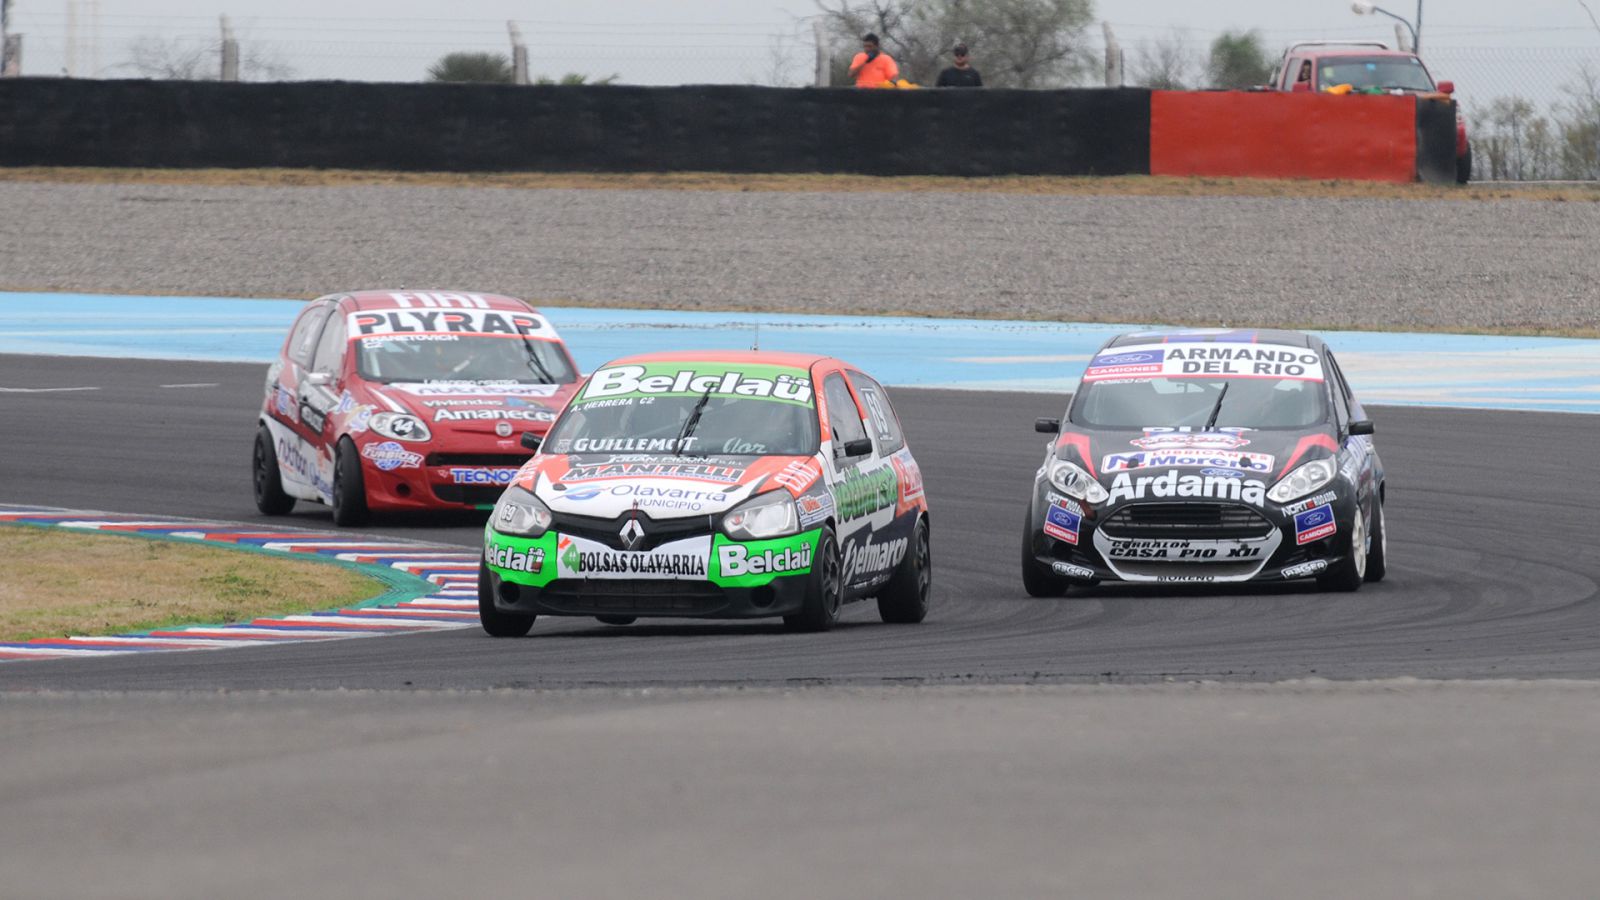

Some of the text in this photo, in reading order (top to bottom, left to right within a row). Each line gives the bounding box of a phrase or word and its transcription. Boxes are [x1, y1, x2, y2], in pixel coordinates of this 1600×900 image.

[355, 311, 542, 335] PLYRAP
[1166, 348, 1320, 365] ARMANDO
[1090, 366, 1159, 375] CAMIONES
[1183, 361, 1306, 376] DEL RIO
[584, 398, 633, 410] HERRERA
[640, 397, 655, 406] C2
[392, 419, 415, 433] 14
[573, 437, 698, 452] GUILLEMOT
[1152, 449, 1268, 461] LUBRICANTES
[1150, 456, 1268, 471] Moreno
[560, 463, 746, 482] MANTELLI
[1106, 470, 1266, 507] Ardama
[633, 498, 702, 511] MUNICIPIO
[1300, 525, 1334, 541] CAMIONES
[1112, 541, 1191, 549] CORRALON
[1109, 548, 1168, 558] CASA
[1179, 549, 1218, 558] PIO
[578, 551, 706, 575] BOLSAS OLAVARRIA
